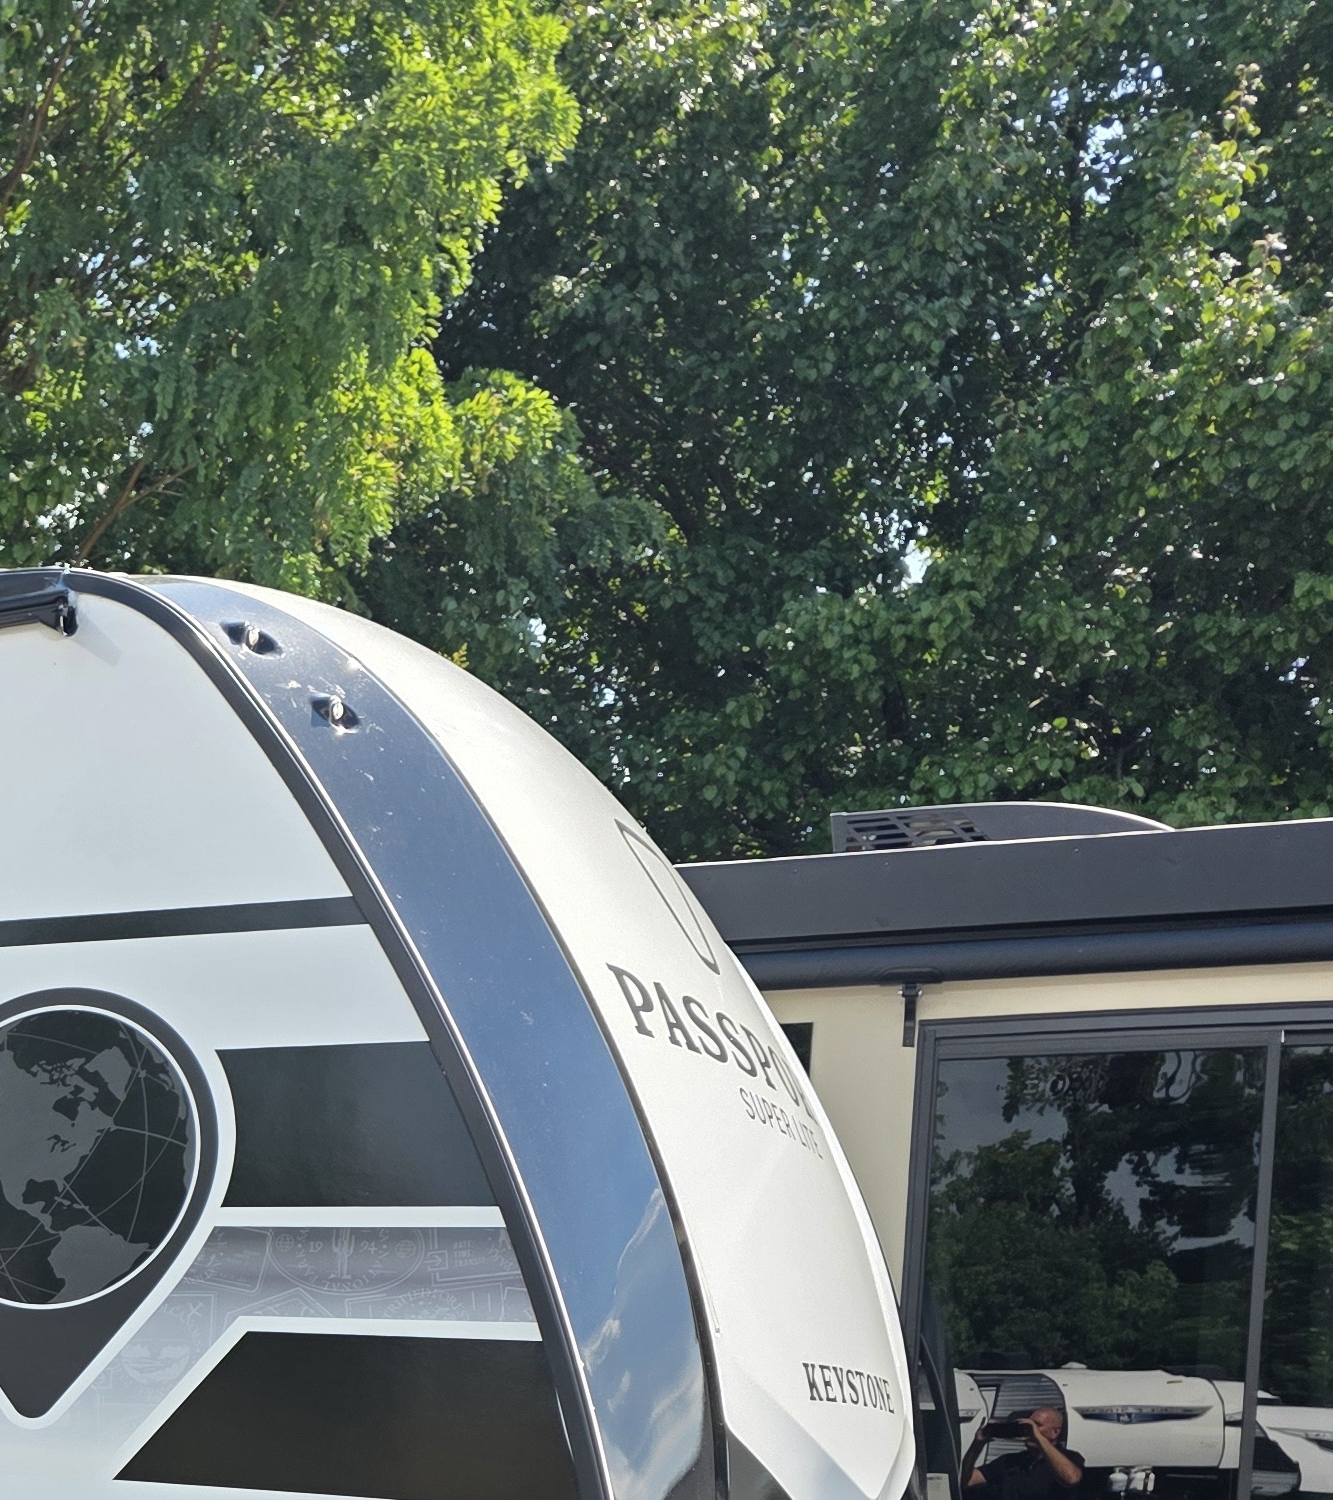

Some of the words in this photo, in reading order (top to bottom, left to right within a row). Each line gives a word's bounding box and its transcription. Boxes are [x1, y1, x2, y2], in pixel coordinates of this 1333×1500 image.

[605, 962, 820, 1126] PASSPO
[739, 1087, 795, 1140] SUPER
[793, 1116, 824, 1160] LITE
[802, 1362, 895, 1414] KEYSTONE
